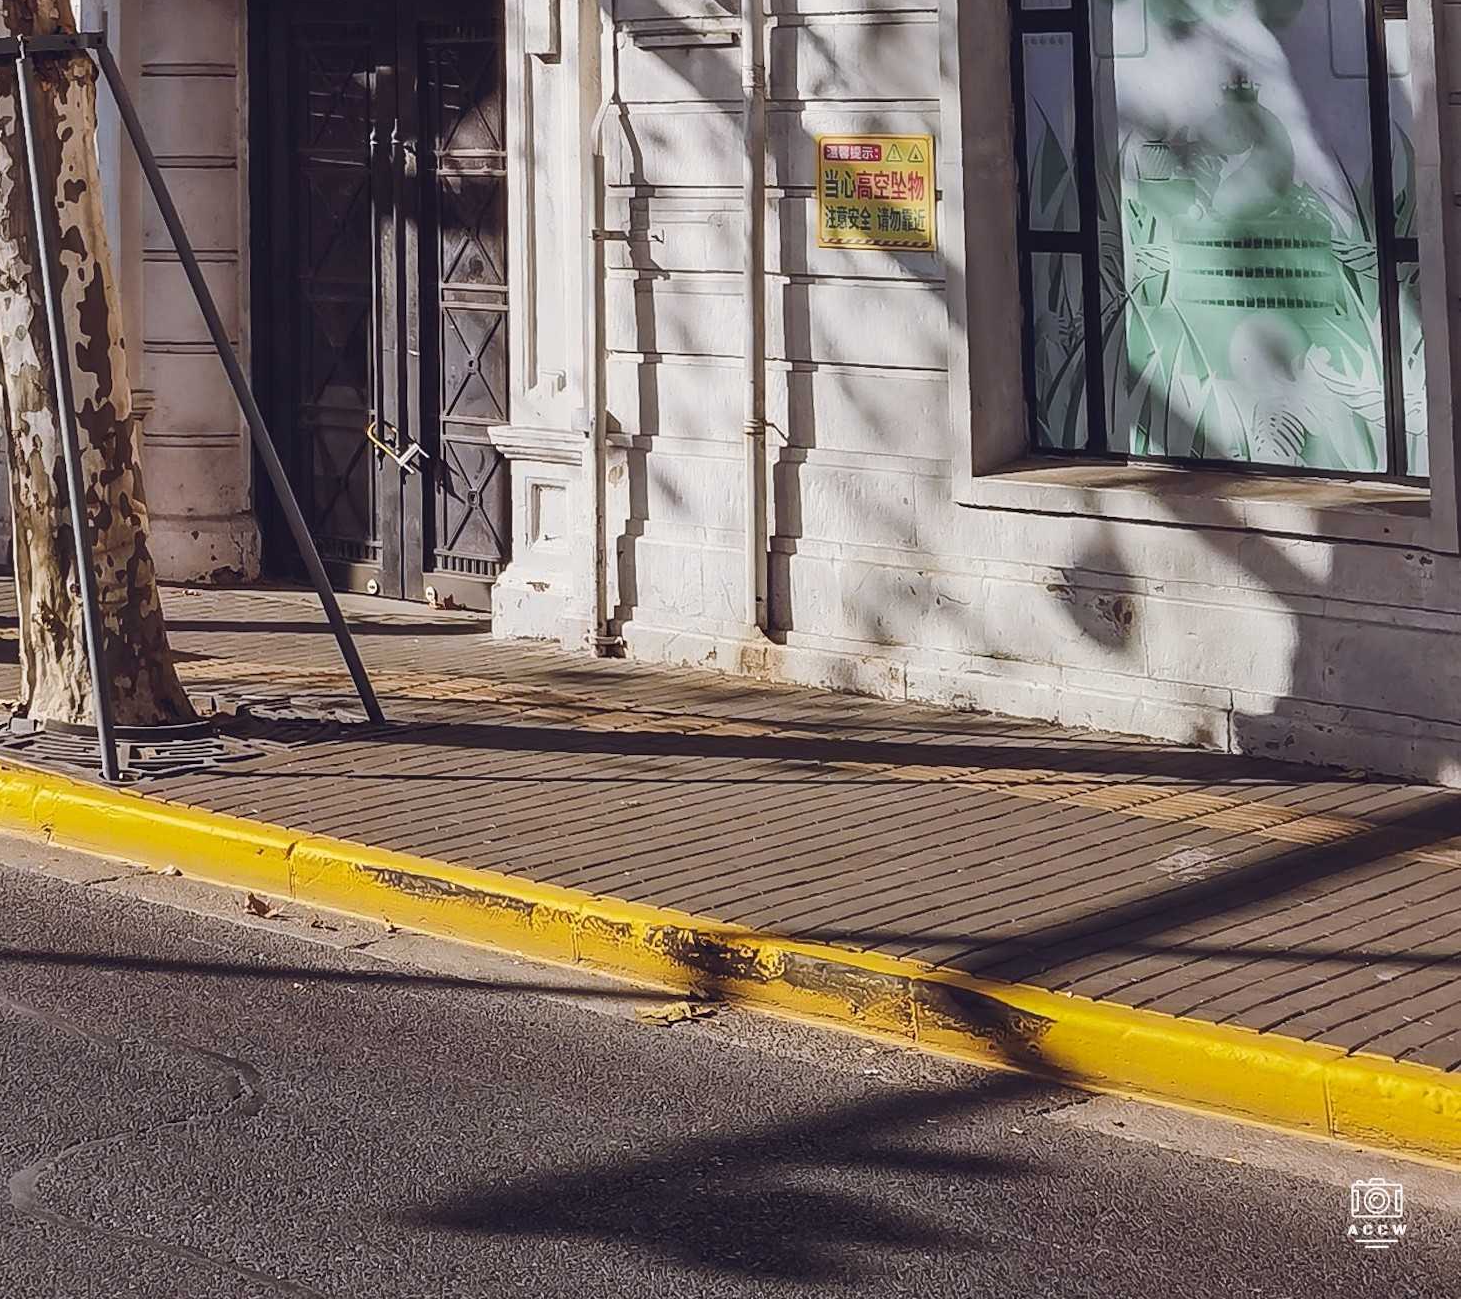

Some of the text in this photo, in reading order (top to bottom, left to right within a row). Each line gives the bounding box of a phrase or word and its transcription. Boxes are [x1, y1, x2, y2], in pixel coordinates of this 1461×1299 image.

[824, 169, 924, 201] 当心高空坠物
[825, 205, 926, 233] 注意安全 请勿靠近
